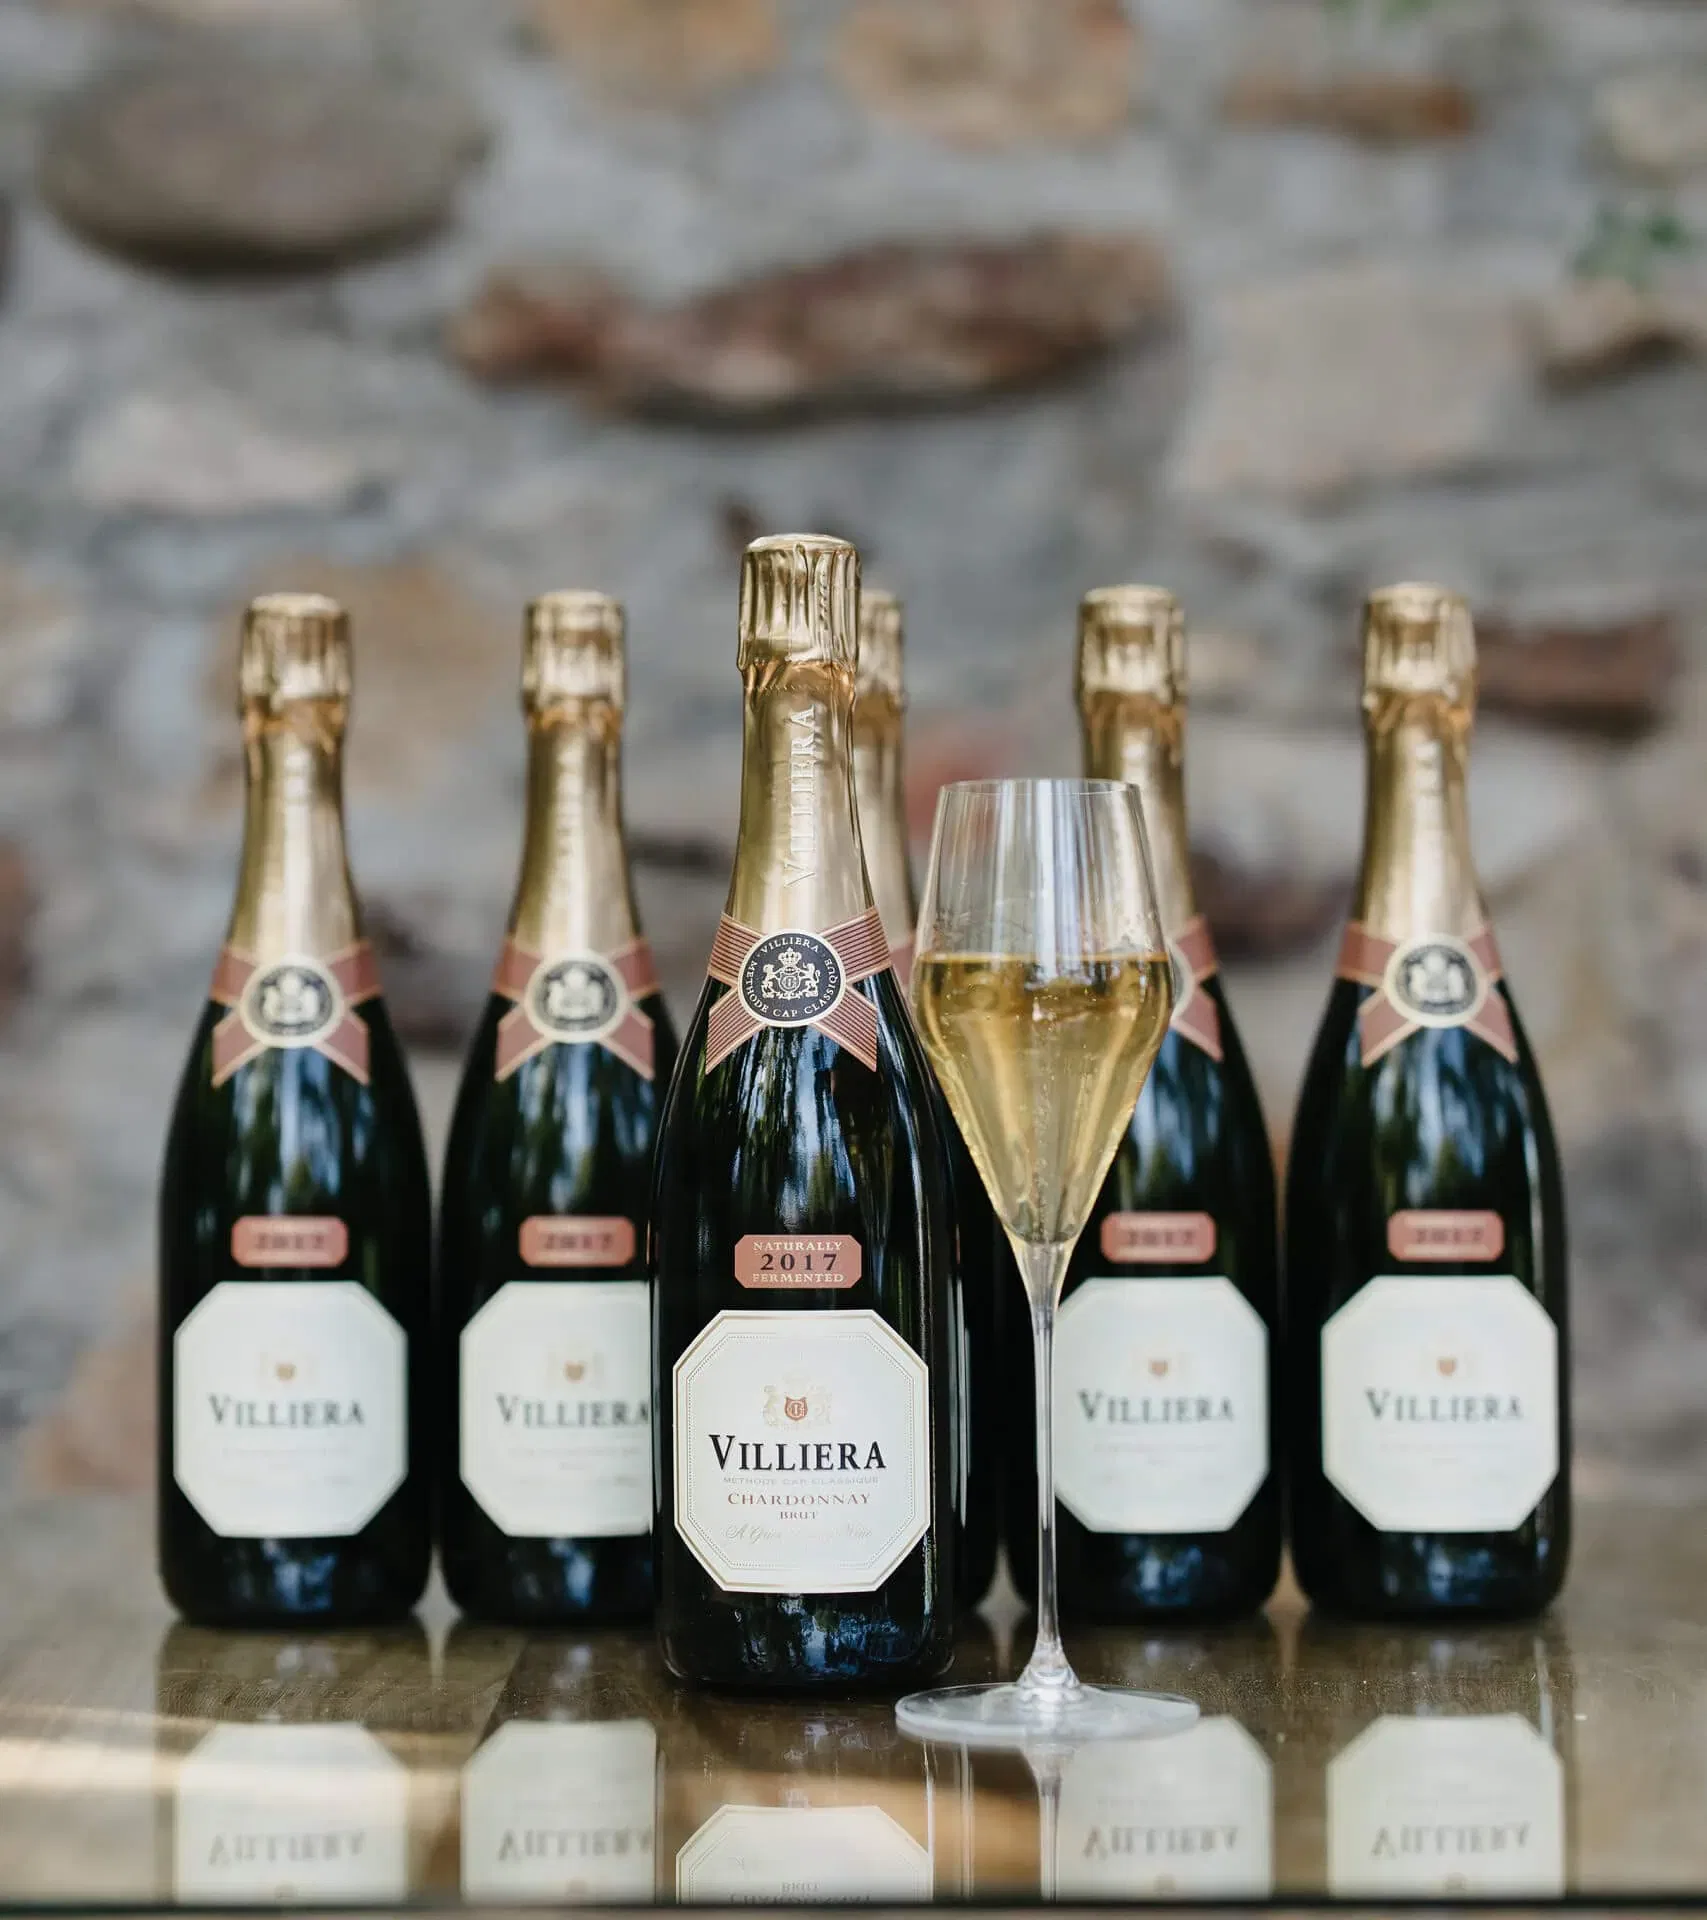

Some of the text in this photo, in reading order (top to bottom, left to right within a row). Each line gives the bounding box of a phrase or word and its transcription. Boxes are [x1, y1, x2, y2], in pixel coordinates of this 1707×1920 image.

[784, 704, 816, 888] VILLIERA
[761, 936, 820, 953] VILLIERA
[745, 957, 839, 1018] METHODE CAP CLASSIQUE
[752, 1241, 842, 1251] NATURALLY
[760, 1253, 837, 1271] 2017
[752, 1273, 844, 1283] FERMENTED
[207, 1393, 366, 1427] VILLIERA
[496, 1393, 650, 1429] VILLIERA
[1077, 1389, 1235, 1425] VILLIERA
[1364, 1388, 1525, 1424] VILLIERA
[708, 1434, 887, 1472] VILLIERA
[723, 1476, 879, 1486] METHODE CAP CLASSIQUE
[727, 1492, 871, 1506] CHARDONNAY
[779, 1510, 818, 1520] BRUT
